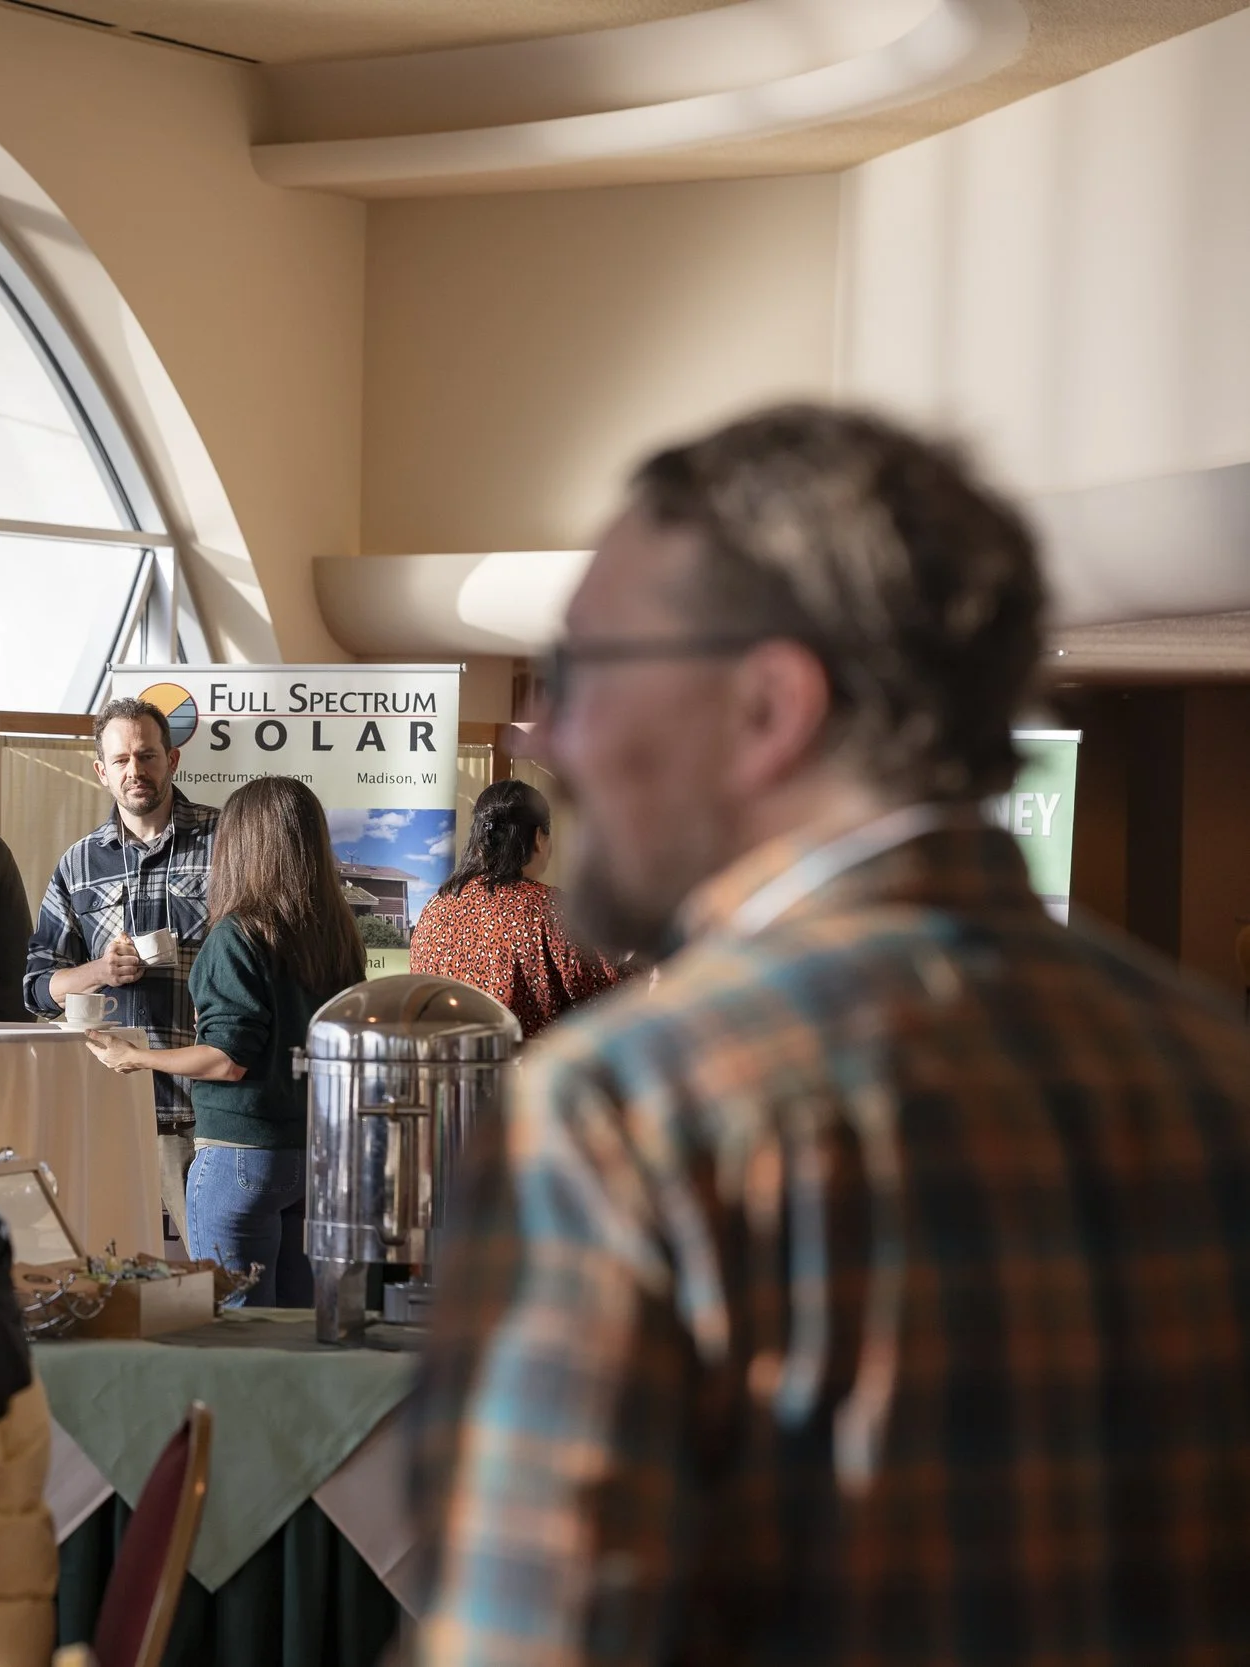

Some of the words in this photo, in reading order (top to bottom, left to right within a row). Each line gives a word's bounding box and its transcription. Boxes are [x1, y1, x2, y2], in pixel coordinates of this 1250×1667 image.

[210, 719, 437, 752] SOLAR
[357, 772, 417, 786] Madison,
[421, 773, 437, 785] WI
[982, 792, 1061, 836] NEY
[366, 956, 385, 969] nal
